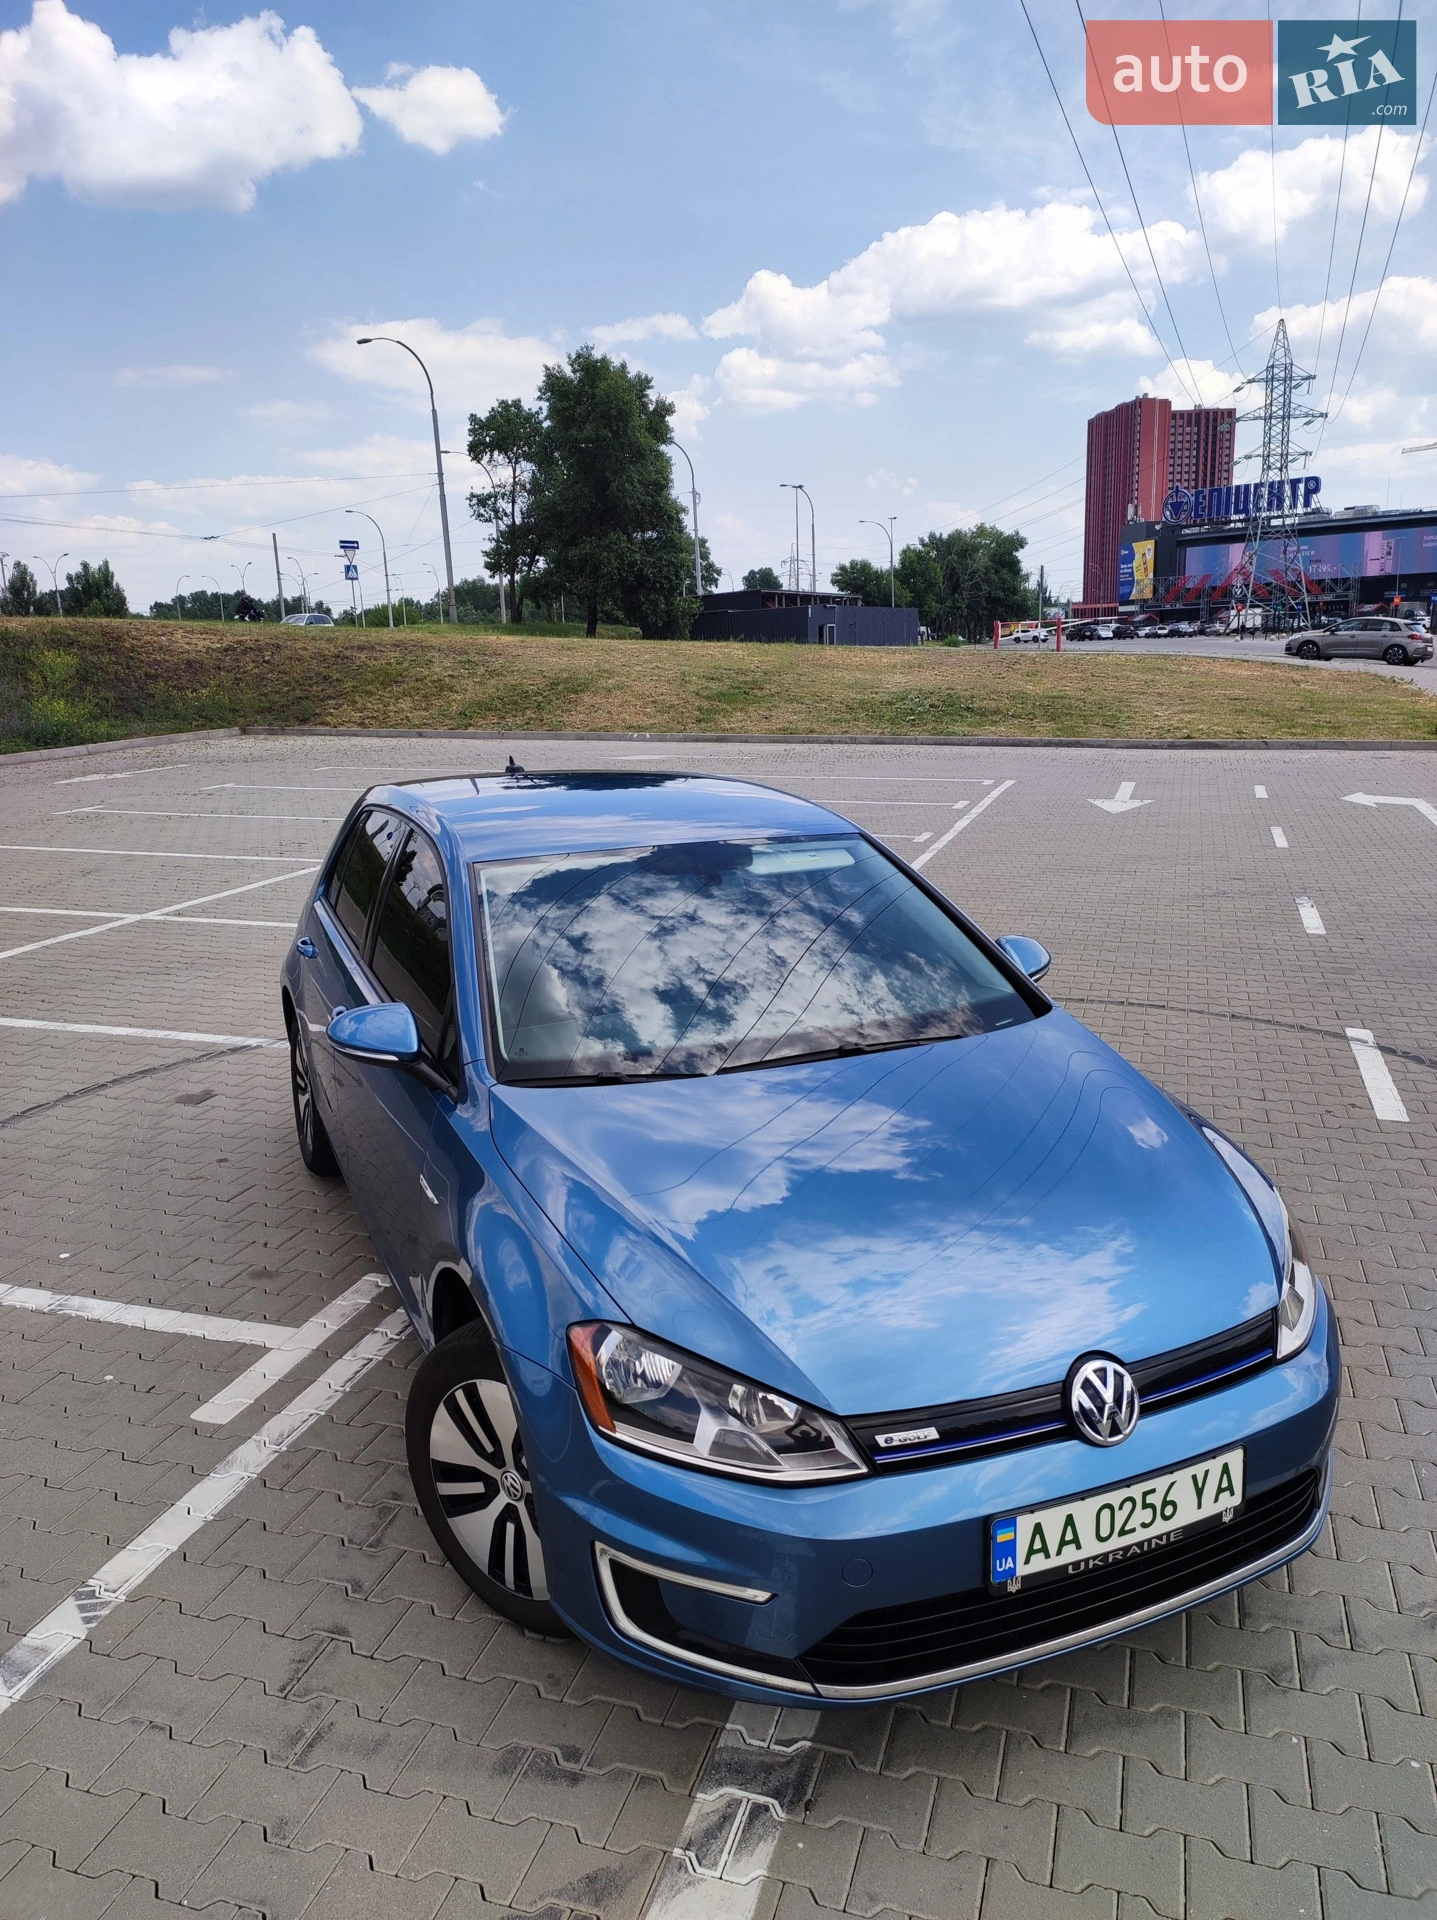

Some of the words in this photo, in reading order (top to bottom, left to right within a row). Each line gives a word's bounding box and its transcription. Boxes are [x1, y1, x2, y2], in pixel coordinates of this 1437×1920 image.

[1023, 1513, 1082, 1566] AA
[1095, 1480, 1178, 1543] 0256
[1191, 1462, 1235, 1510] YA
[996, 1556, 1015, 1572] UA
[1067, 1529, 1184, 1575] UKRAINE
